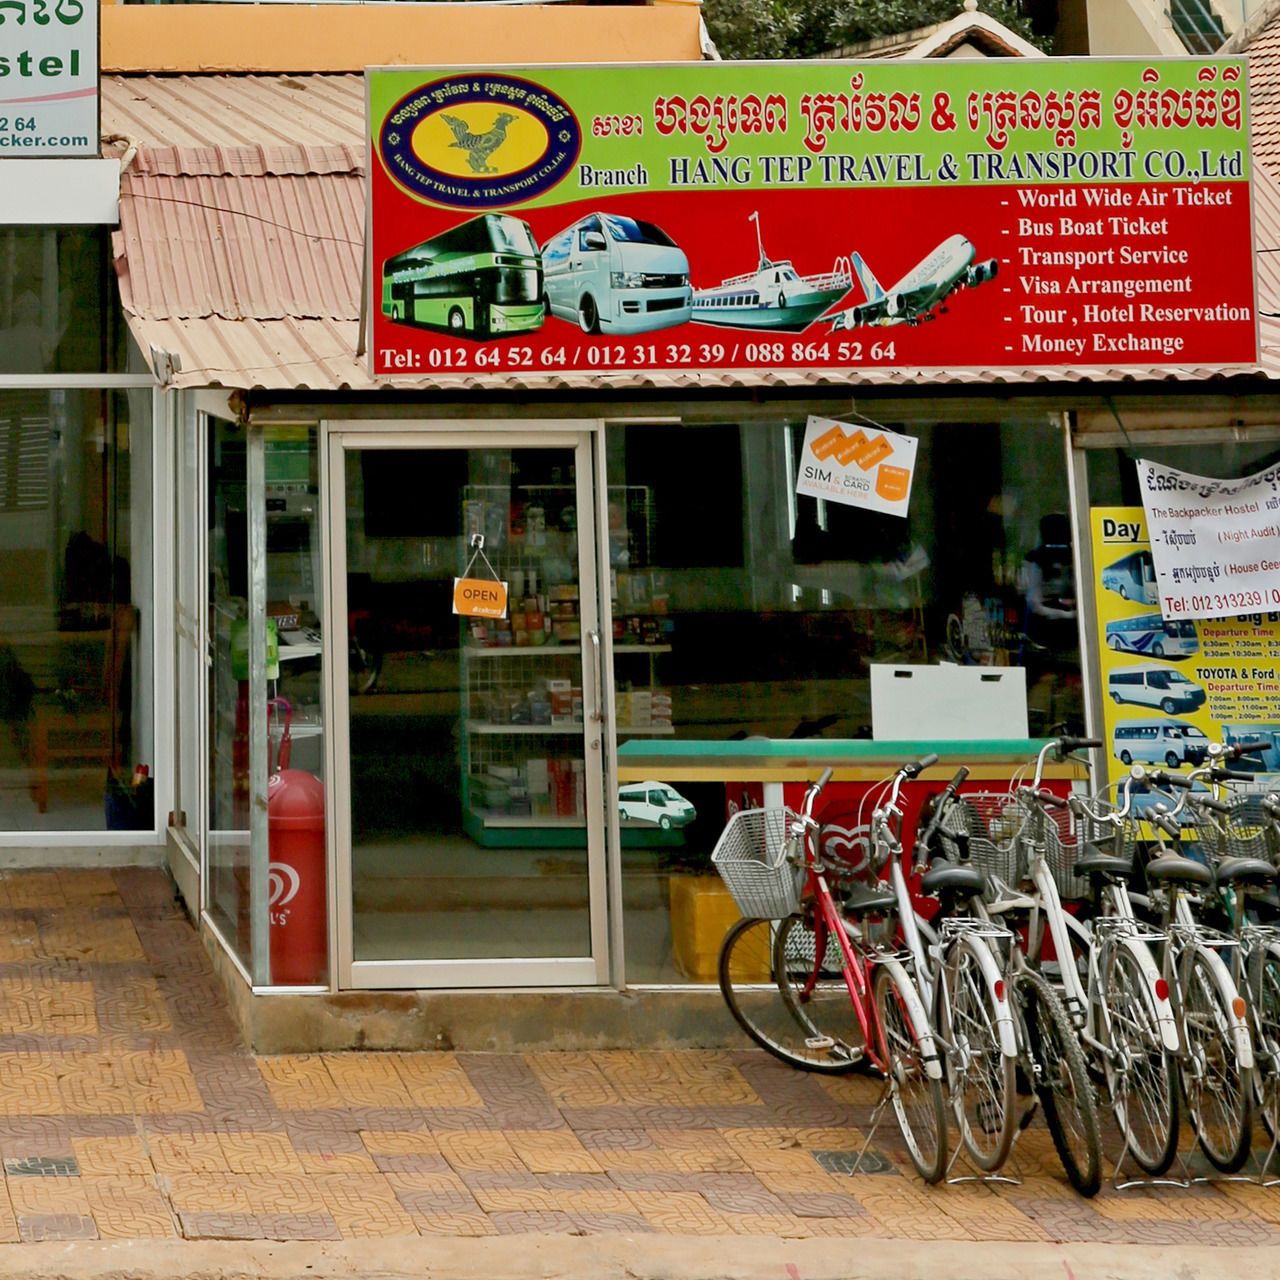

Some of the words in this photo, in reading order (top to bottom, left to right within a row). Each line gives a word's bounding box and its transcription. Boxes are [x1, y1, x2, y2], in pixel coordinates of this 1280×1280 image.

[930, 89, 957, 133] &
[14, 117, 36, 131] 64
[393, 153, 415, 176] HANG
[415, 172, 434, 187] TEP
[433, 179, 471, 198] TRAVEL
[473, 189, 481, 198] &
[483, 176, 540, 198] TRANSPORT
[580, 163, 647, 186] Branch
[670, 156, 751, 184] HANG
[757, 155, 812, 184] TEP
[819, 153, 931, 183] TRAVEL
[938, 152, 959, 181] &
[967, 150, 1136, 181] TRANSPORT
[1017, 189, 1077, 207] World
[1083, 188, 1132, 206] Wide
[1137, 188, 1169, 206] Air
[1173, 187, 1233, 206] Ticket
[1018, 218, 1053, 236] Bus
[1059, 217, 1104, 236] Boat
[1108, 217, 1169, 235] Ticket
[1018, 247, 1115, 269] Transport
[1119, 246, 1189, 264] Service
[1019, 276, 1061, 294] Visa
[1065, 275, 1193, 298] Arrangement
[1020, 305, 1067, 324] Tour
[1083, 304, 1135, 323] Hotel
[1139, 303, 1251, 322] Reservation
[380, 348, 421, 368] Tel:
[428, 347, 467, 367] 012
[474, 347, 501, 366] 64
[507, 347, 533, 366] 52
[540, 347, 567, 366] 64
[587, 346, 626, 365] 012
[633, 345, 657, 364] 31
[665, 345, 692, 364] 32
[699, 343, 725, 363] 39
[745, 343, 785, 362] 088
[791, 342, 831, 362] 864
[837, 342, 863, 361] 52
[870, 341, 896, 360] 64
[1021, 334, 1087, 356] Money
[1092, 333, 1185, 355] Exchange
[804, 465, 832, 483] SIM
[843, 479, 870, 492] CARD
[1152, 508, 1168, 518] The
[1169, 505, 1222, 519] Backpacker
[1224, 502, 1259, 516] Hostel
[1103, 519, 1141, 543] Day
[1229, 563, 1259, 574] House
[463, 589, 498, 601] OPEN
[1165, 597, 1190, 612] Tel:
[1193, 595, 1212, 611] 012
[1216, 590, 1261, 609] 313239
[1203, 628, 1248, 638] Departure
[1252, 627, 1274, 636] Time
[1196, 668, 1237, 679] TOYOTA
[1241, 668, 1248, 679] &
[1252, 668, 1274, 679] Ford
[1208, 683, 1253, 692] Departure
[1257, 683, 1279, 691] Time
